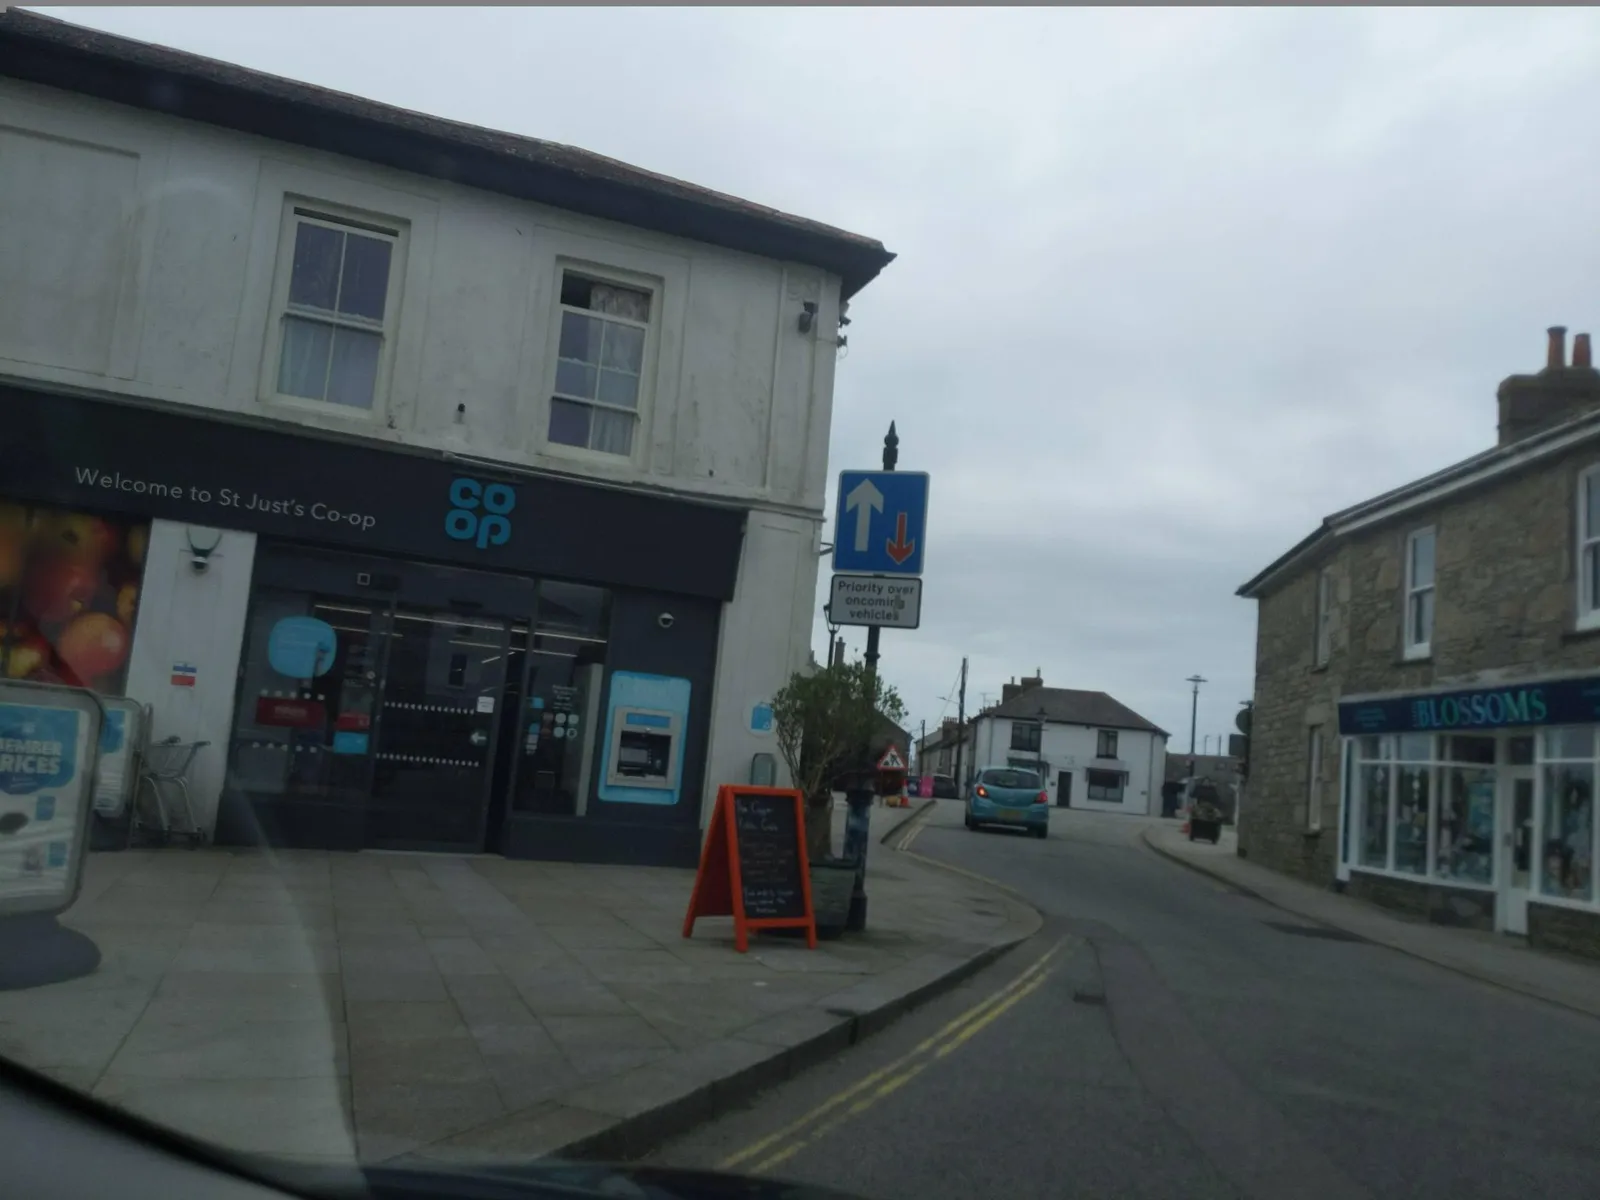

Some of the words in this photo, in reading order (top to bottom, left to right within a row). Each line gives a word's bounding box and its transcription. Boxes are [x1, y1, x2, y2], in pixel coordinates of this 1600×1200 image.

[75, 466, 183, 499] Welcome
[189, 486, 212, 503] to
[218, 488, 241, 507] St
[245, 493, 305, 517] Just's
[310, 503, 376, 531] Co-op
[838, 580, 884, 595] Priority
[887, 585, 915, 595] over
[849, 608, 899, 621] vehicles
[1416, 689, 1547, 727] BLOSSOMS
[0, 738, 62, 755] EMBER
